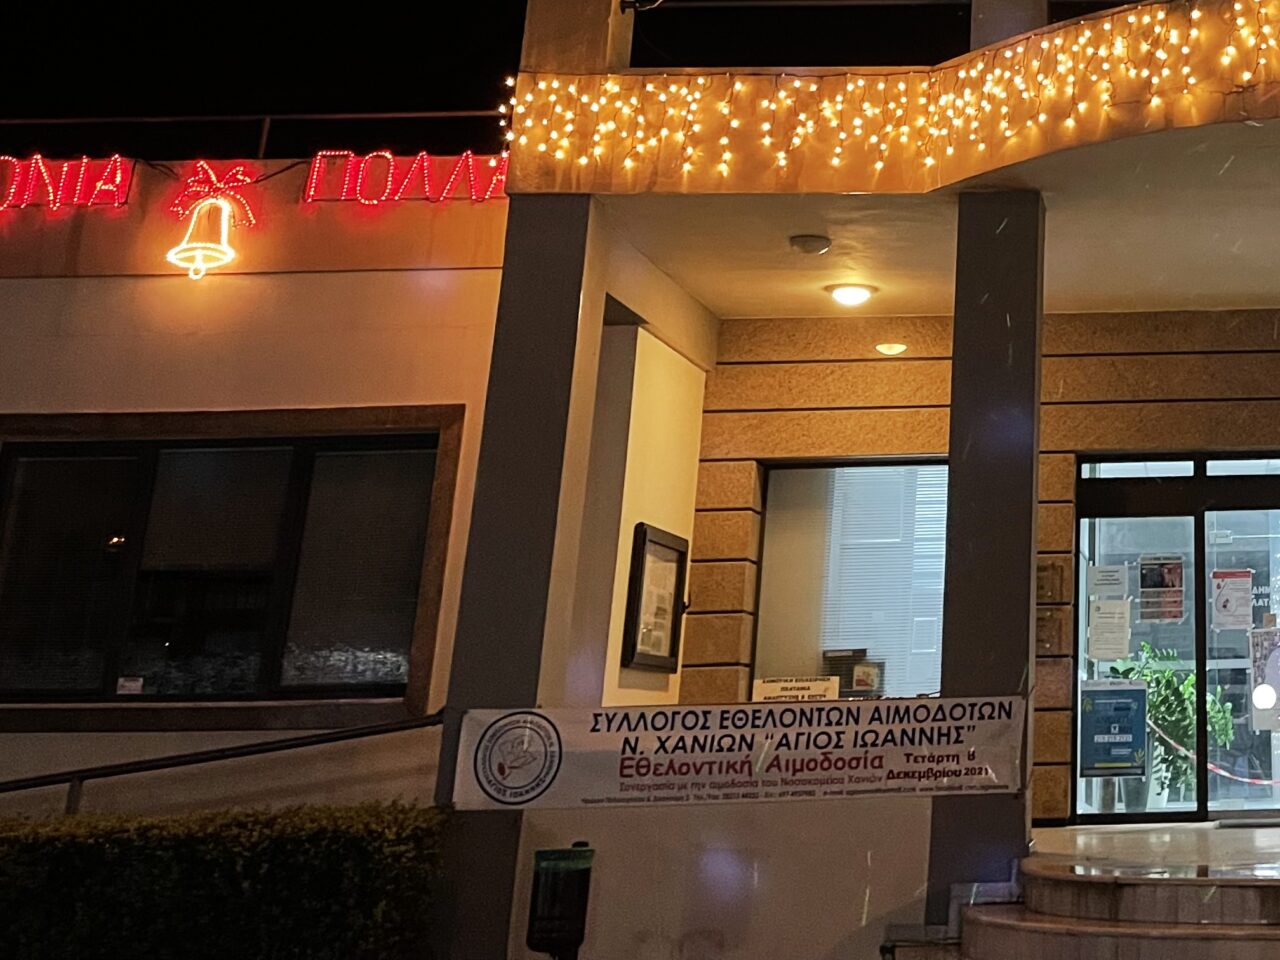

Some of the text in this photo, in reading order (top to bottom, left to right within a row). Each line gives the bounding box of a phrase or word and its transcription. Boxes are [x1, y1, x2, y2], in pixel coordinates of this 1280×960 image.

[589, 700, 1014, 733] ΣΥΛΛΟΓΟΣ ΕΘΕΛΟΝΤΩΝ ΑΙΜΟΔΟΤΩΝ
[621, 736, 644, 756] Ν.
[654, 733, 755, 755] ΧΑΝΙΩΝ
[619, 749, 885, 778] Εθελοντική Αιμοδοσία
[903, 751, 960, 765] Τετάρτη
[886, 766, 988, 781] Δεκεμβρίου 2021
